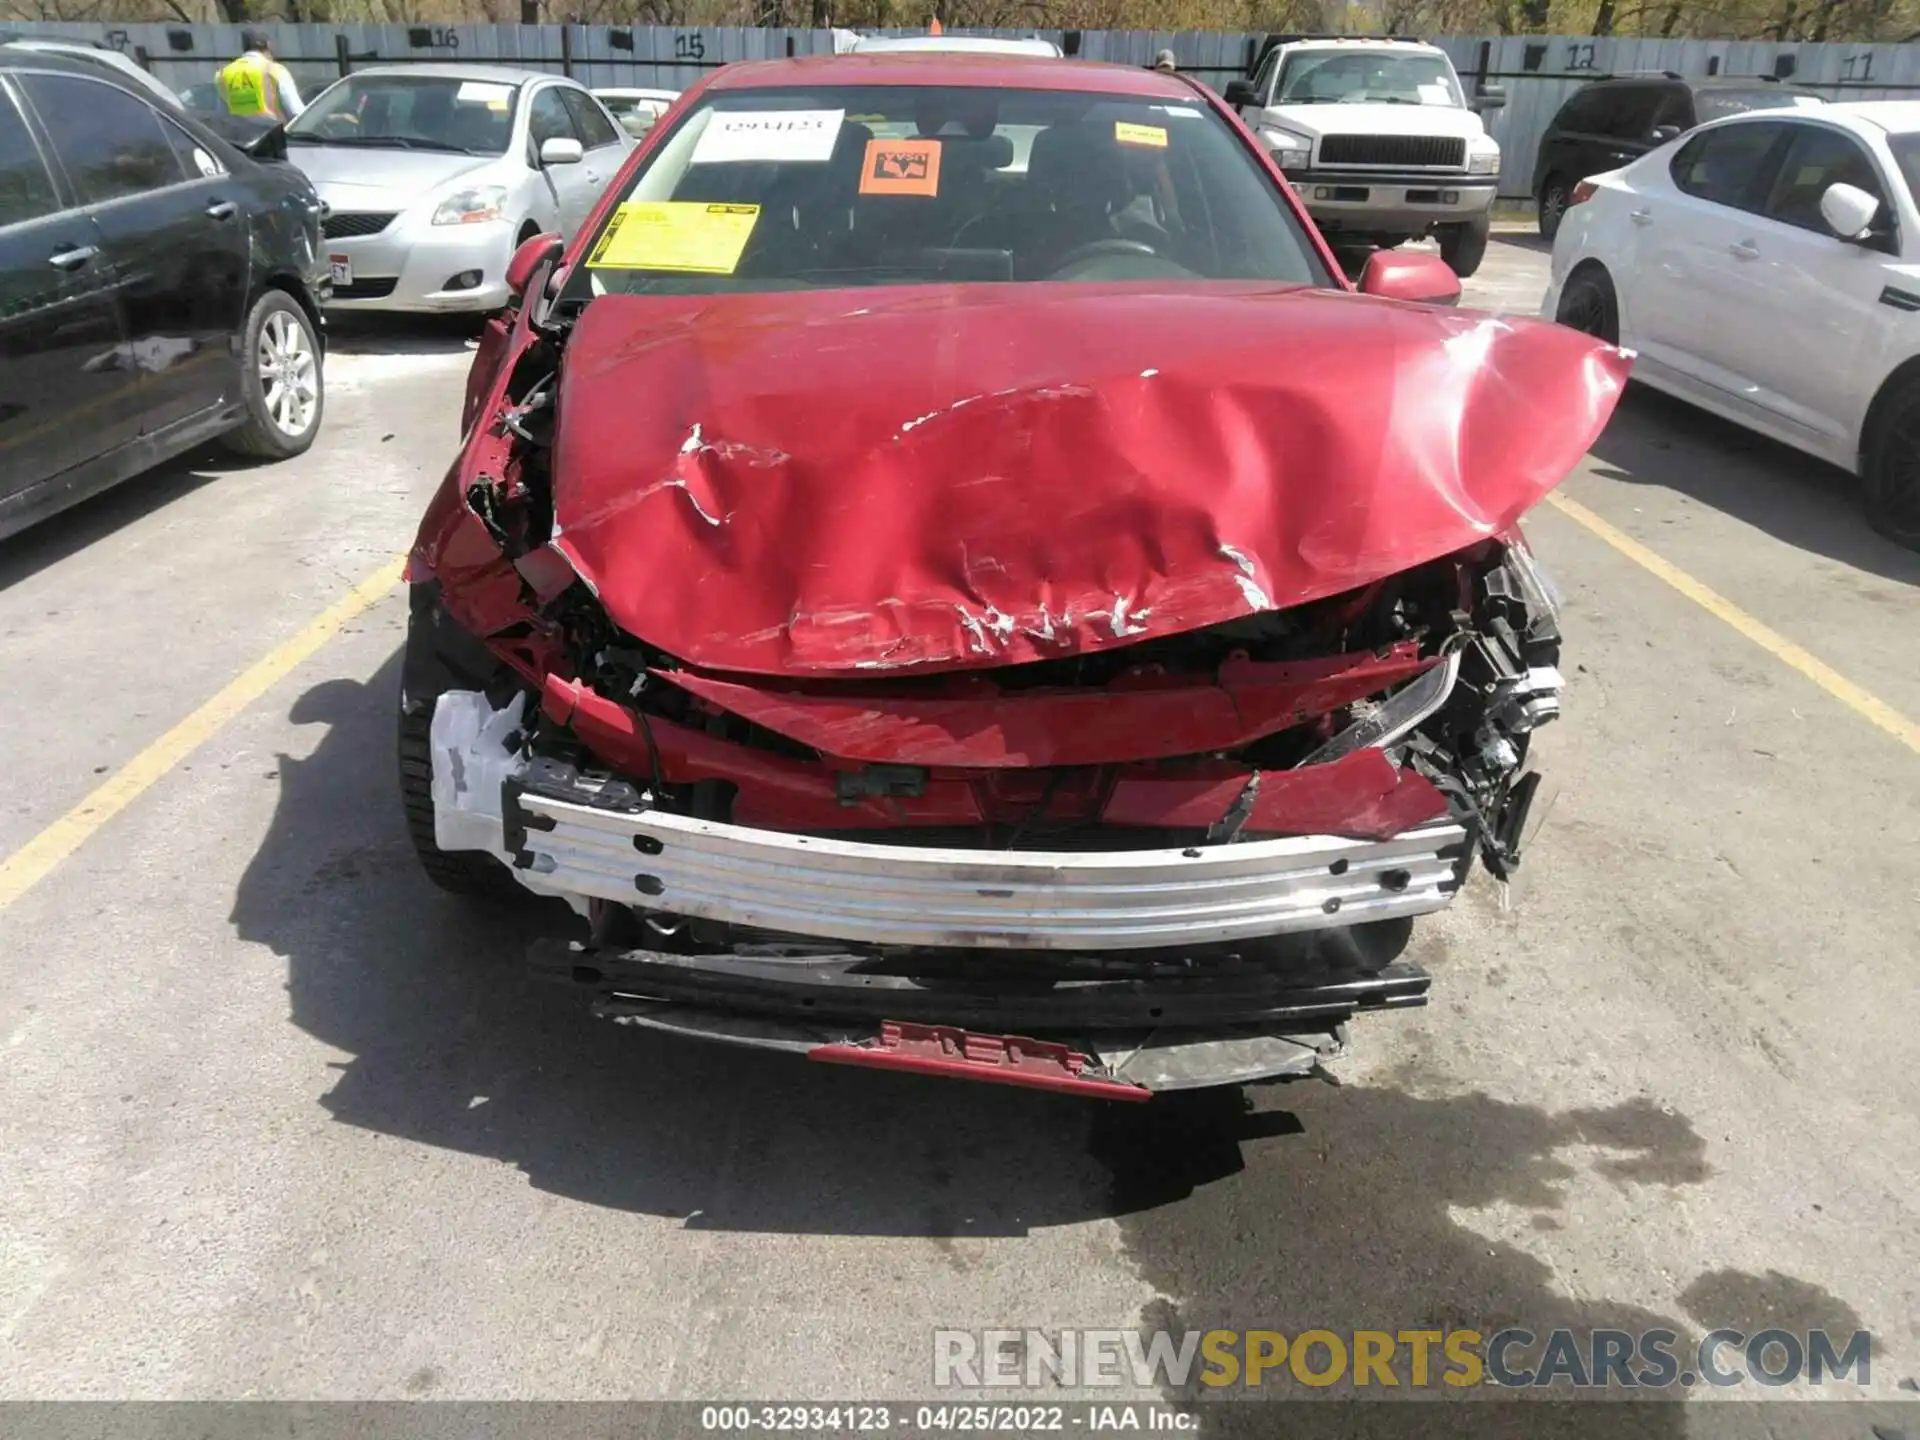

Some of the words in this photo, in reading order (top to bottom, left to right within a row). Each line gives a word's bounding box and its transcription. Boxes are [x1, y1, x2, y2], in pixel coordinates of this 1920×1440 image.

[434, 28, 460, 48] 16
[675, 33, 705, 59] 15
[1564, 44, 1602, 72] 12
[1837, 51, 1875, 81] 11
